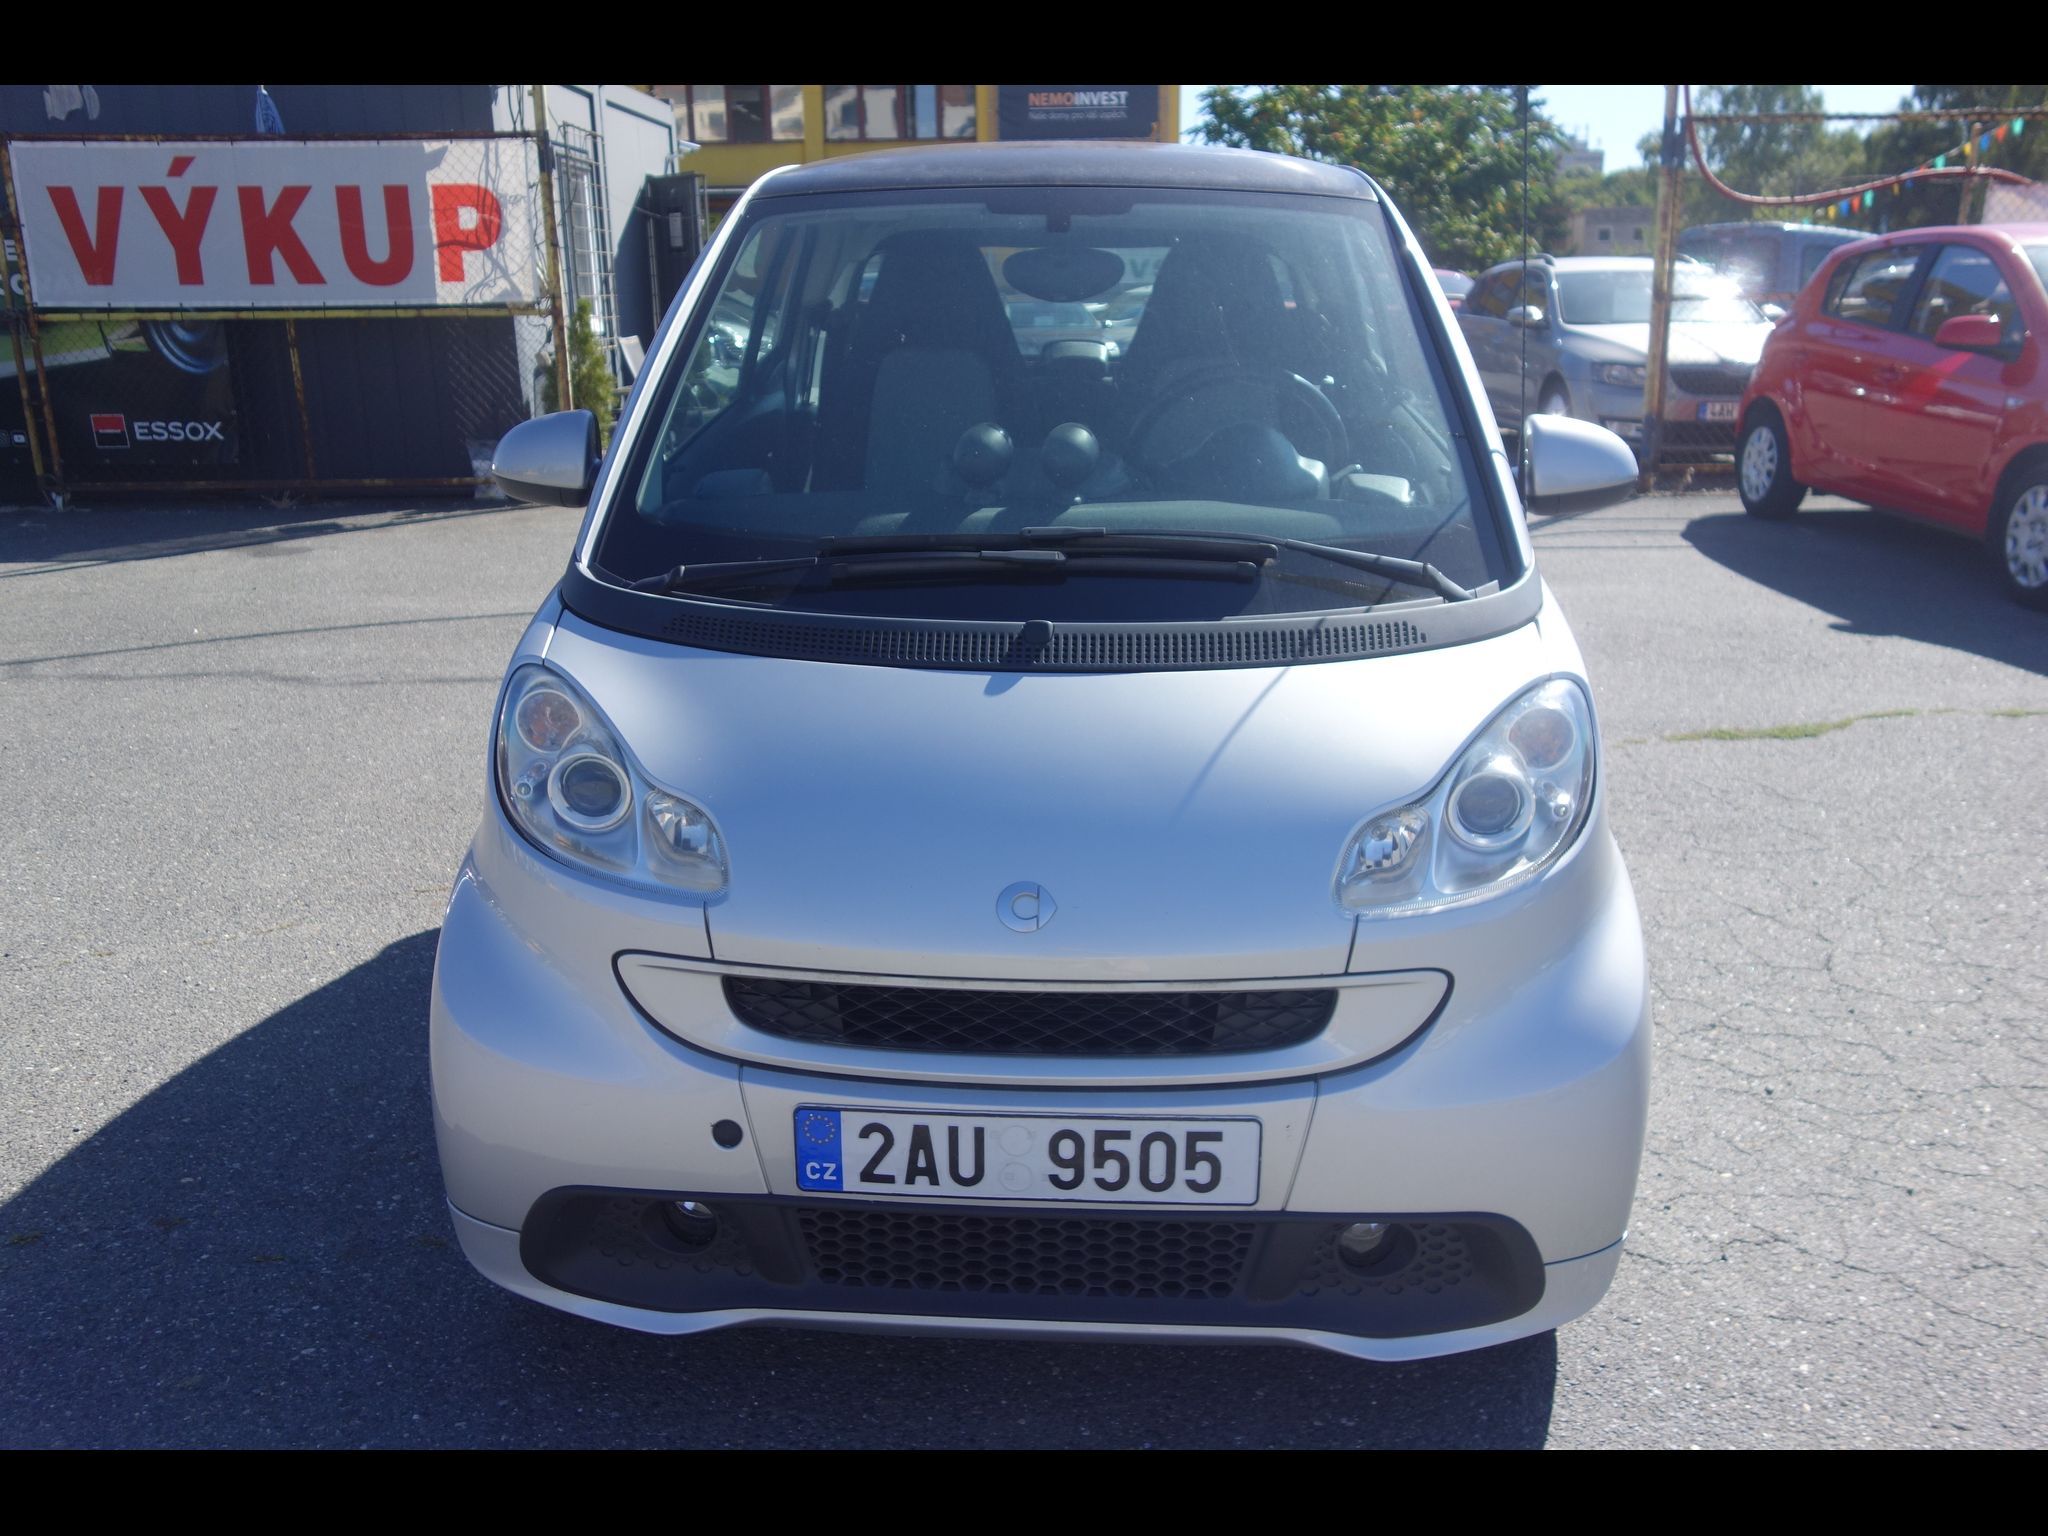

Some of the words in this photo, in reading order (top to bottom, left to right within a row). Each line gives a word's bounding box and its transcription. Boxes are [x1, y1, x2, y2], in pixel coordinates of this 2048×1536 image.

[1028, 91, 1128, 106] NEMOINVEST
[46, 155, 502, 287] VÝKUP
[133, 420, 224, 442] ESSOX
[858, 1122, 985, 1187] 2AU
[1047, 1128, 1223, 1193] 9505
[805, 1162, 837, 1181] CZ
